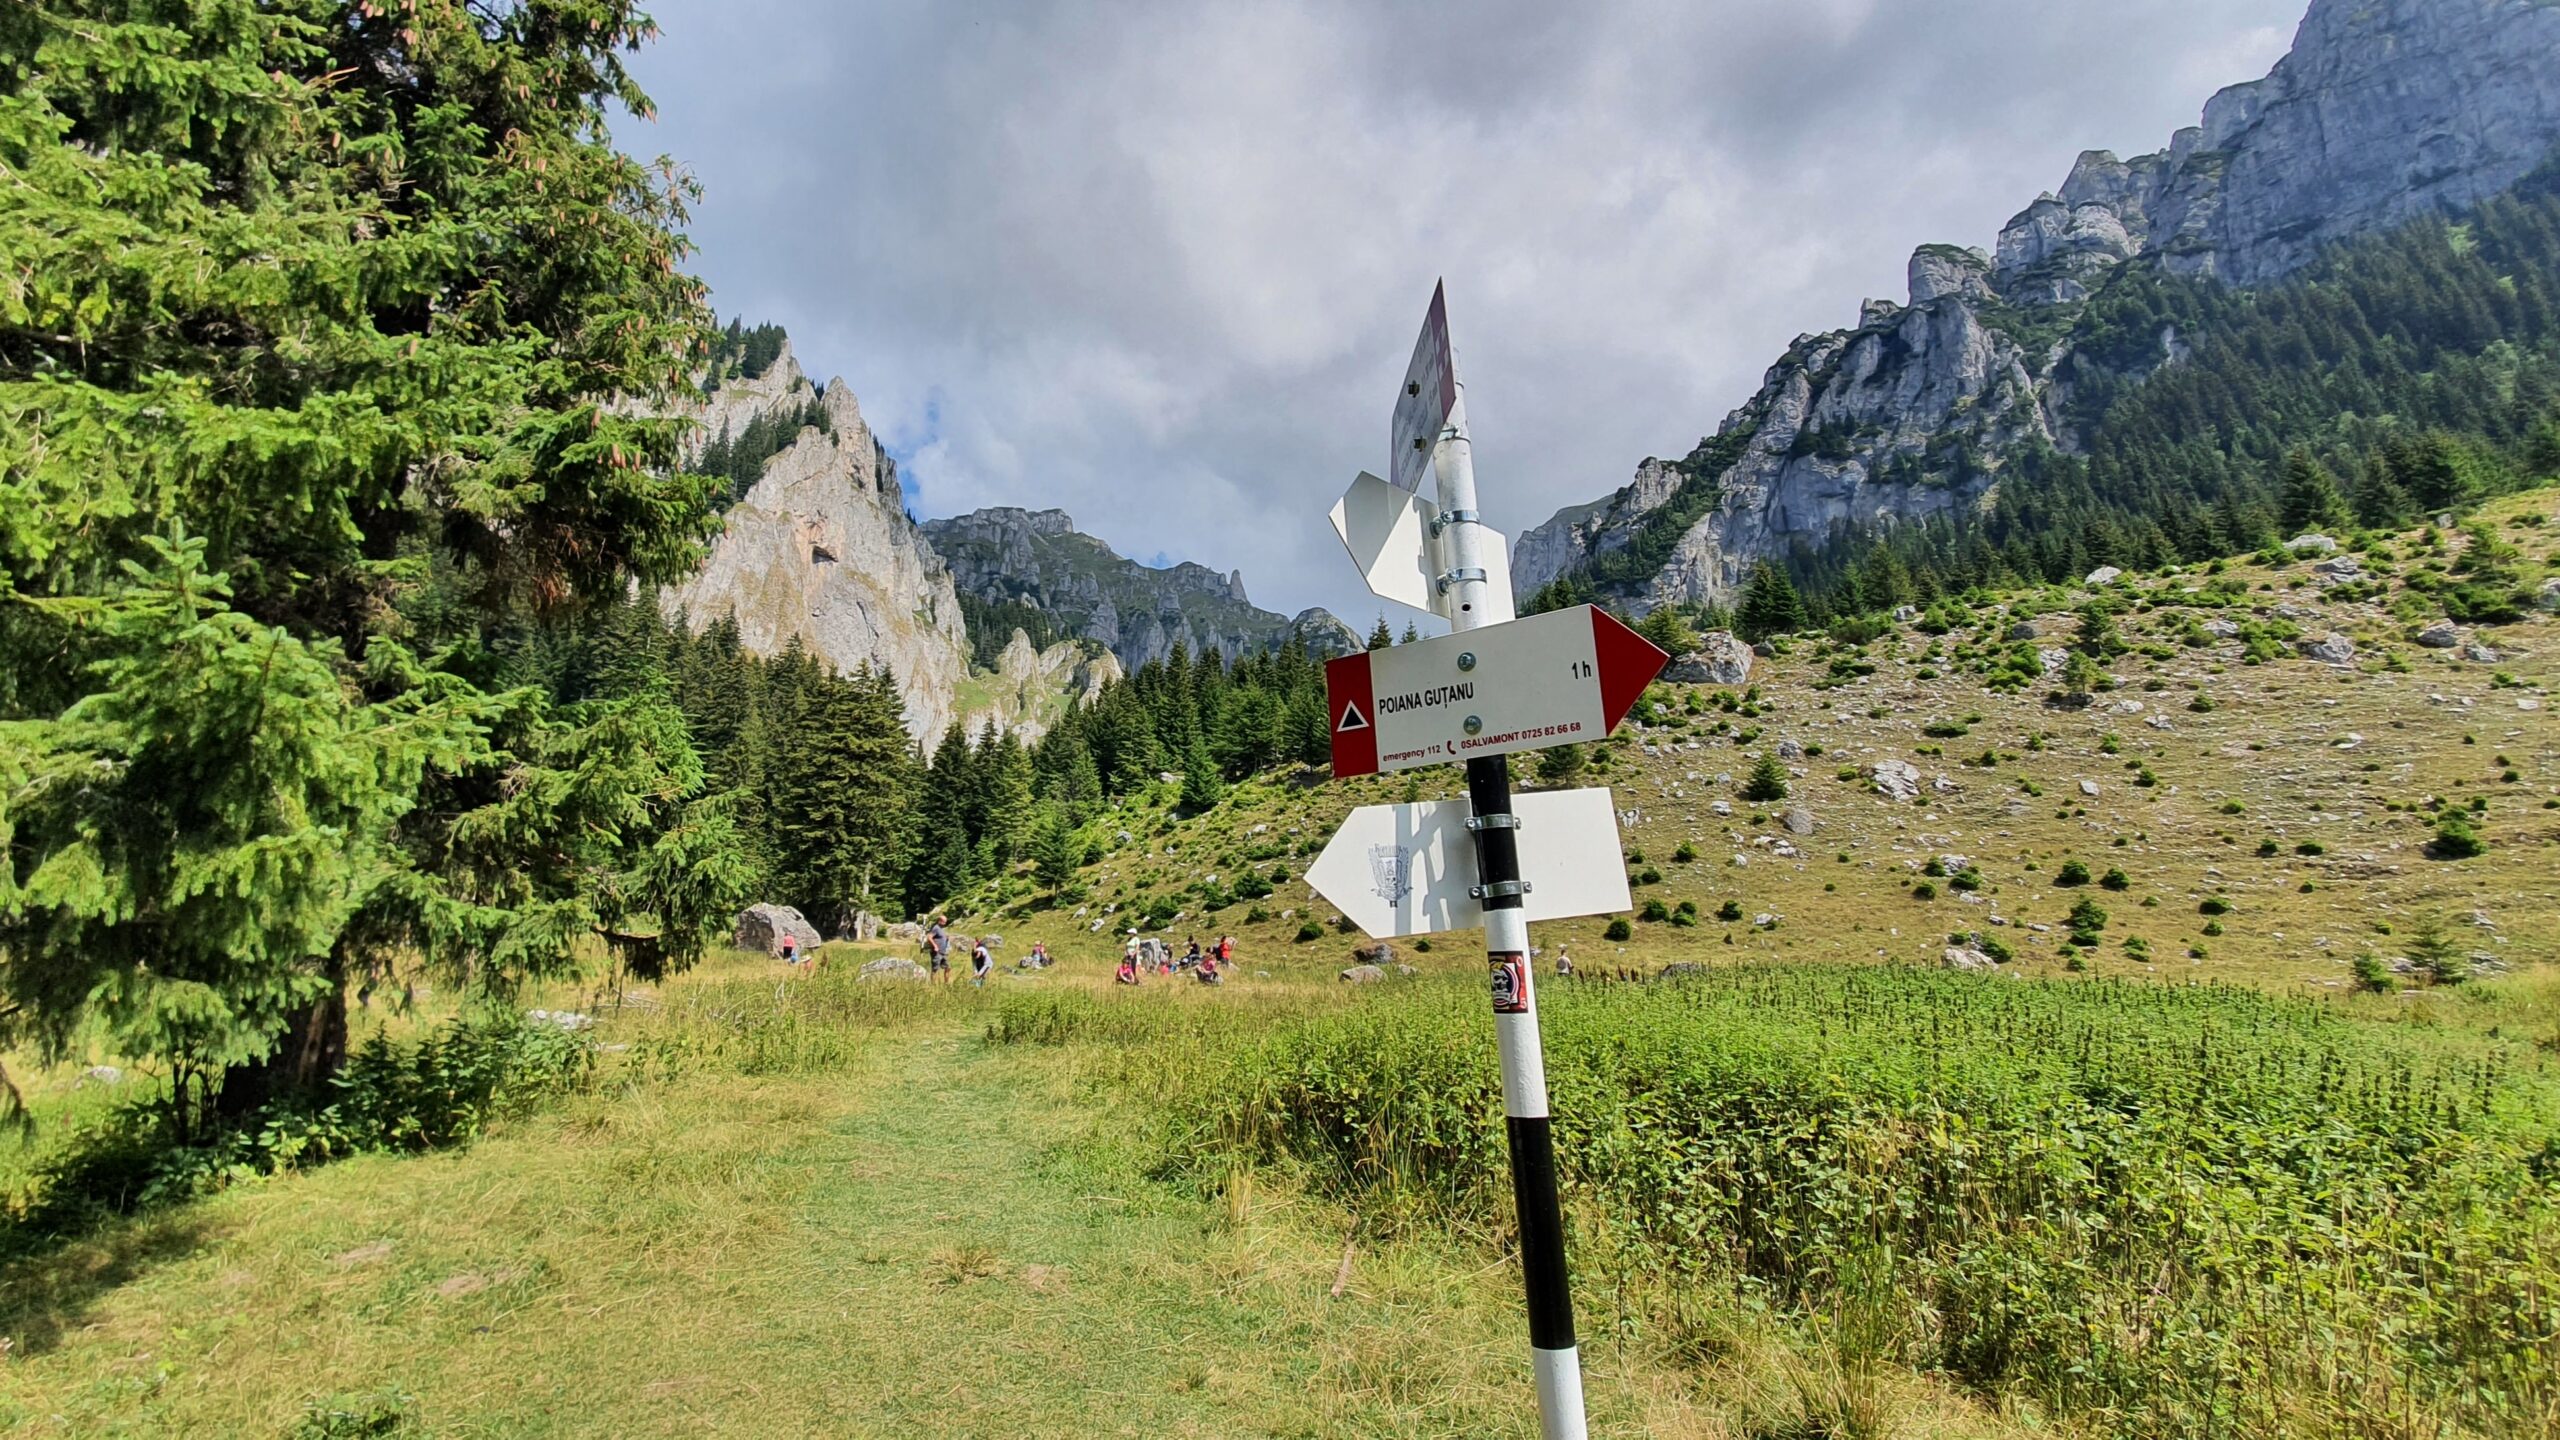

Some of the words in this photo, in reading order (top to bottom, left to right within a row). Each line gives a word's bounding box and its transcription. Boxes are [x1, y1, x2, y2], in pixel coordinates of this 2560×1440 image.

[1572, 662, 1578, 680] 1
[1582, 660, 1591, 678] h
[1379, 692, 1422, 714] POIANA
[1424, 682, 1473, 708] GUȚANU
[1383, 749, 1425, 761] emergency
[1427, 745, 1441, 754] 112
[1522, 729, 1542, 739] 0725
[1544, 726, 1555, 736] 82
[1557, 724, 1568, 734] 66
[1570, 722, 1581, 732] 68
